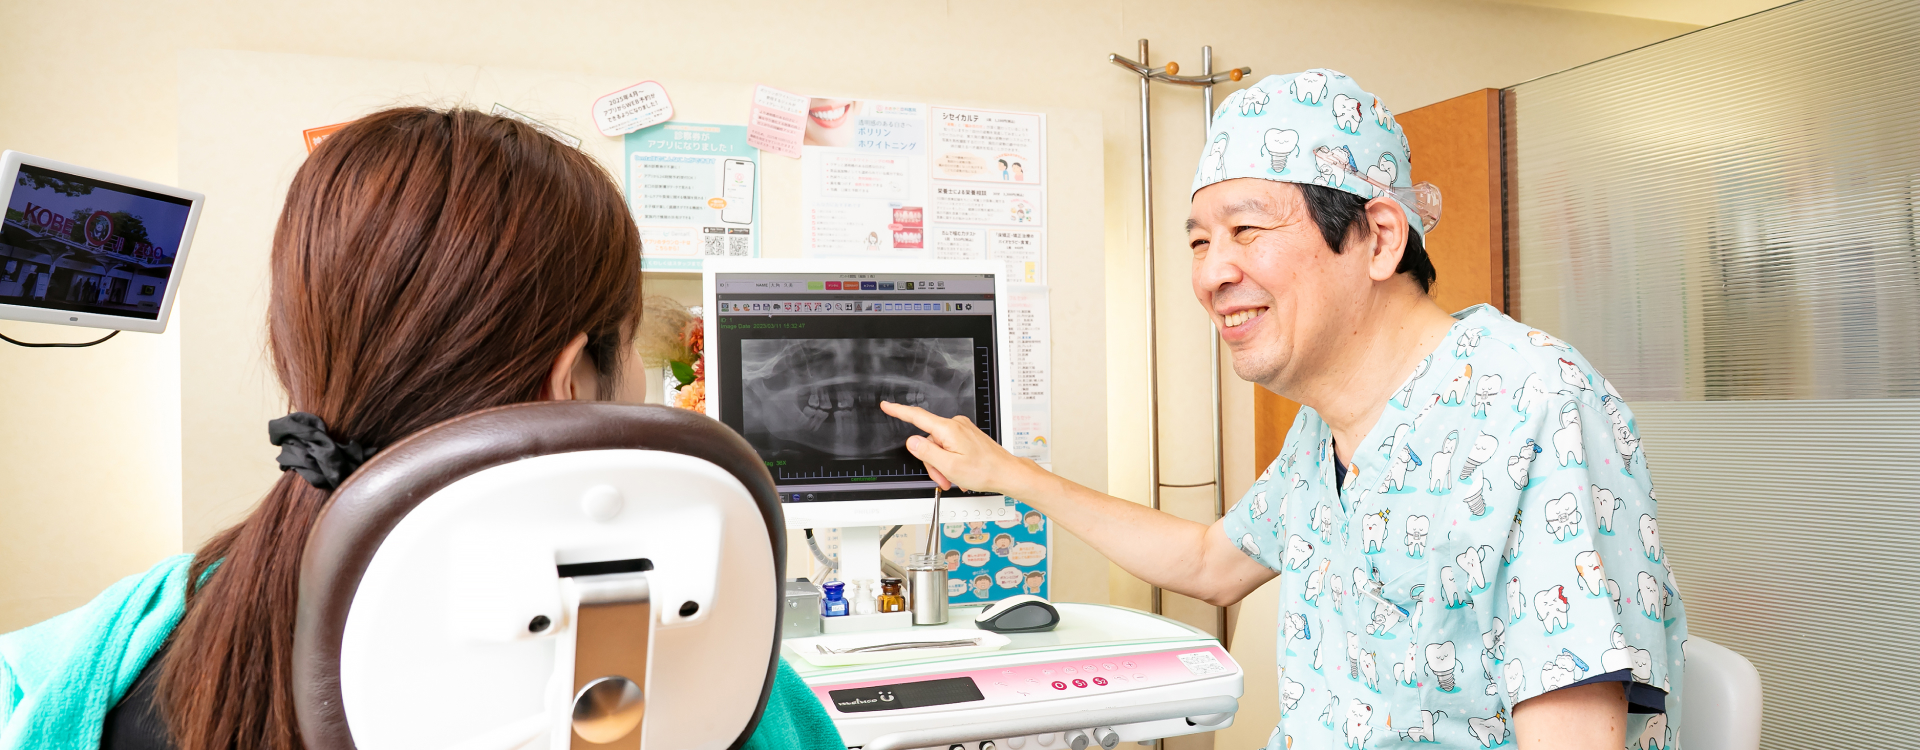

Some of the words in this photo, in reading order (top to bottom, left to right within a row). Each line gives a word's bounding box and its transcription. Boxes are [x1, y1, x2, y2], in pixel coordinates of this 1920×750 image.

[942, 112, 979, 123] シセイカルテ
[858, 119, 912, 128] 透明感のある白さへ
[674, 131, 710, 141] 診察券が
[858, 127, 891, 137] ポリリン
[648, 140, 734, 152] アプリになりました！
[858, 139, 917, 151] ホワイトニング
[23, 201, 75, 236] KOBE
[133, 241, 164, 260] ZOO
